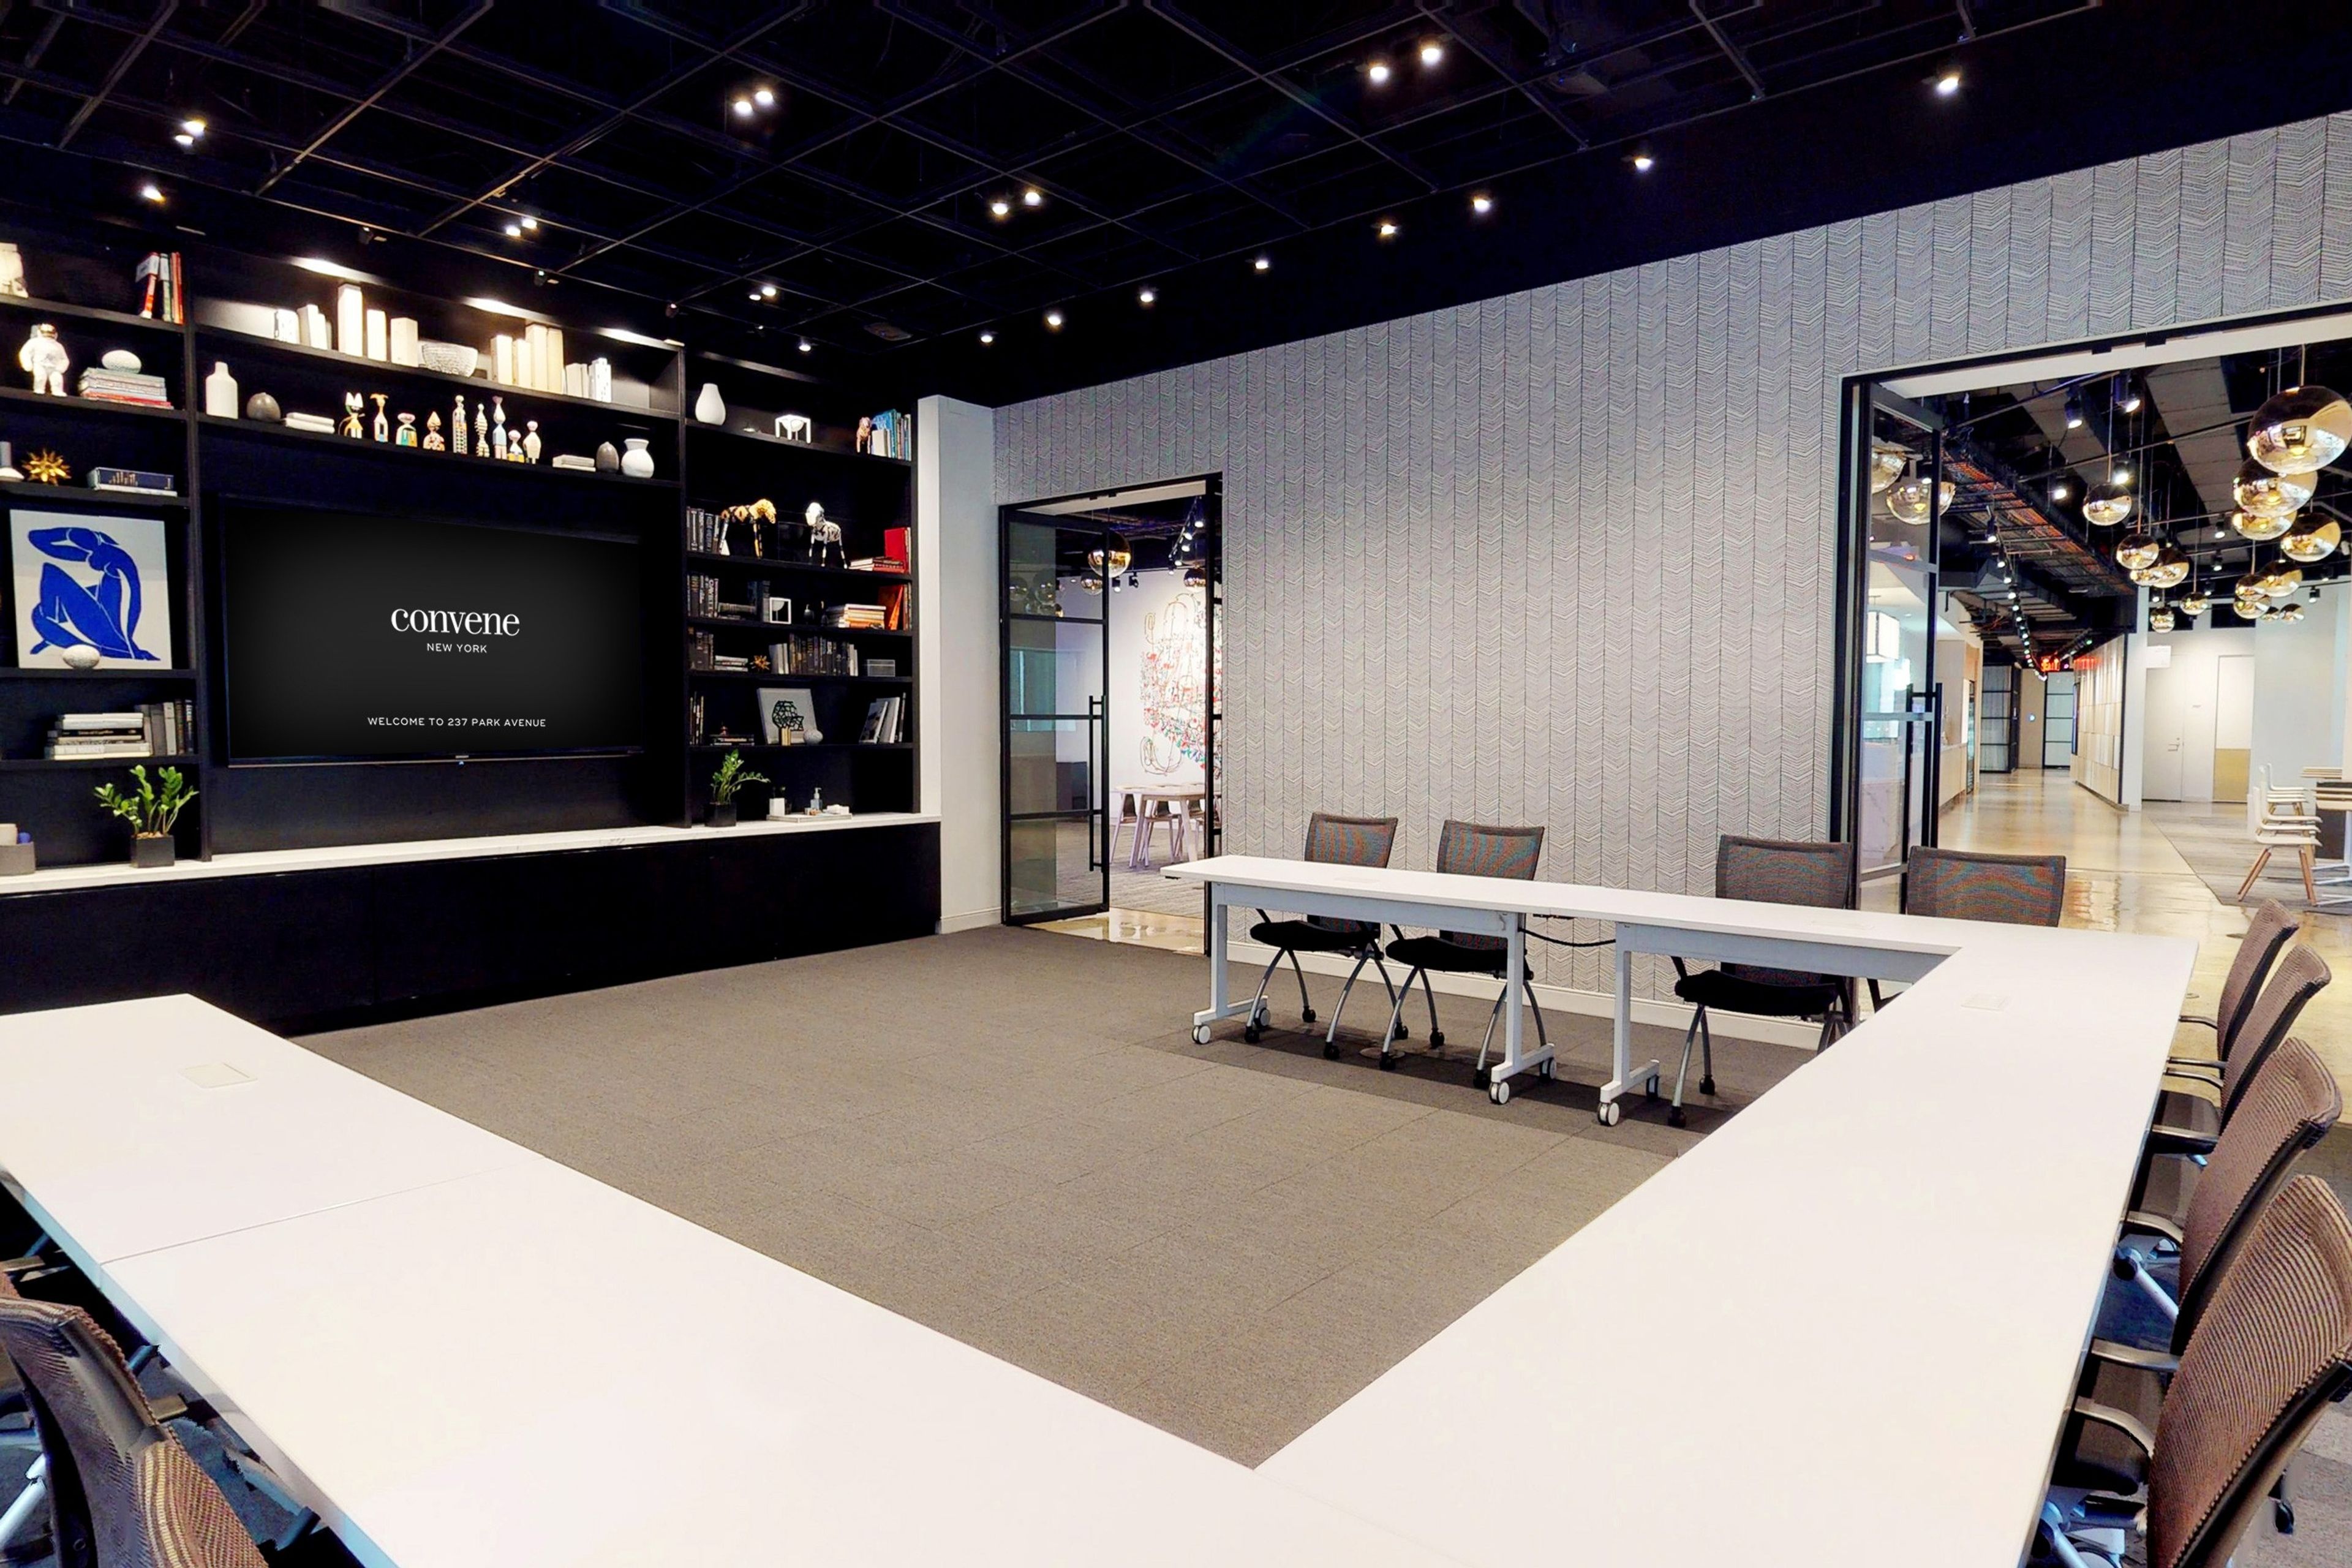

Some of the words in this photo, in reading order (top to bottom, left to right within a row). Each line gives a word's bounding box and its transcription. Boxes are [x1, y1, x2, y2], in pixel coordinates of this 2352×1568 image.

[391, 608, 520, 636] convene
[426, 643, 453, 652] NEW
[456, 644, 488, 654] YORK
[367, 717, 425, 726] WELCOME
[428, 717, 444, 726] TO
[447, 717, 468, 726] 237
[471, 718, 500, 727] PARK
[503, 718, 546, 727] AVENUE
